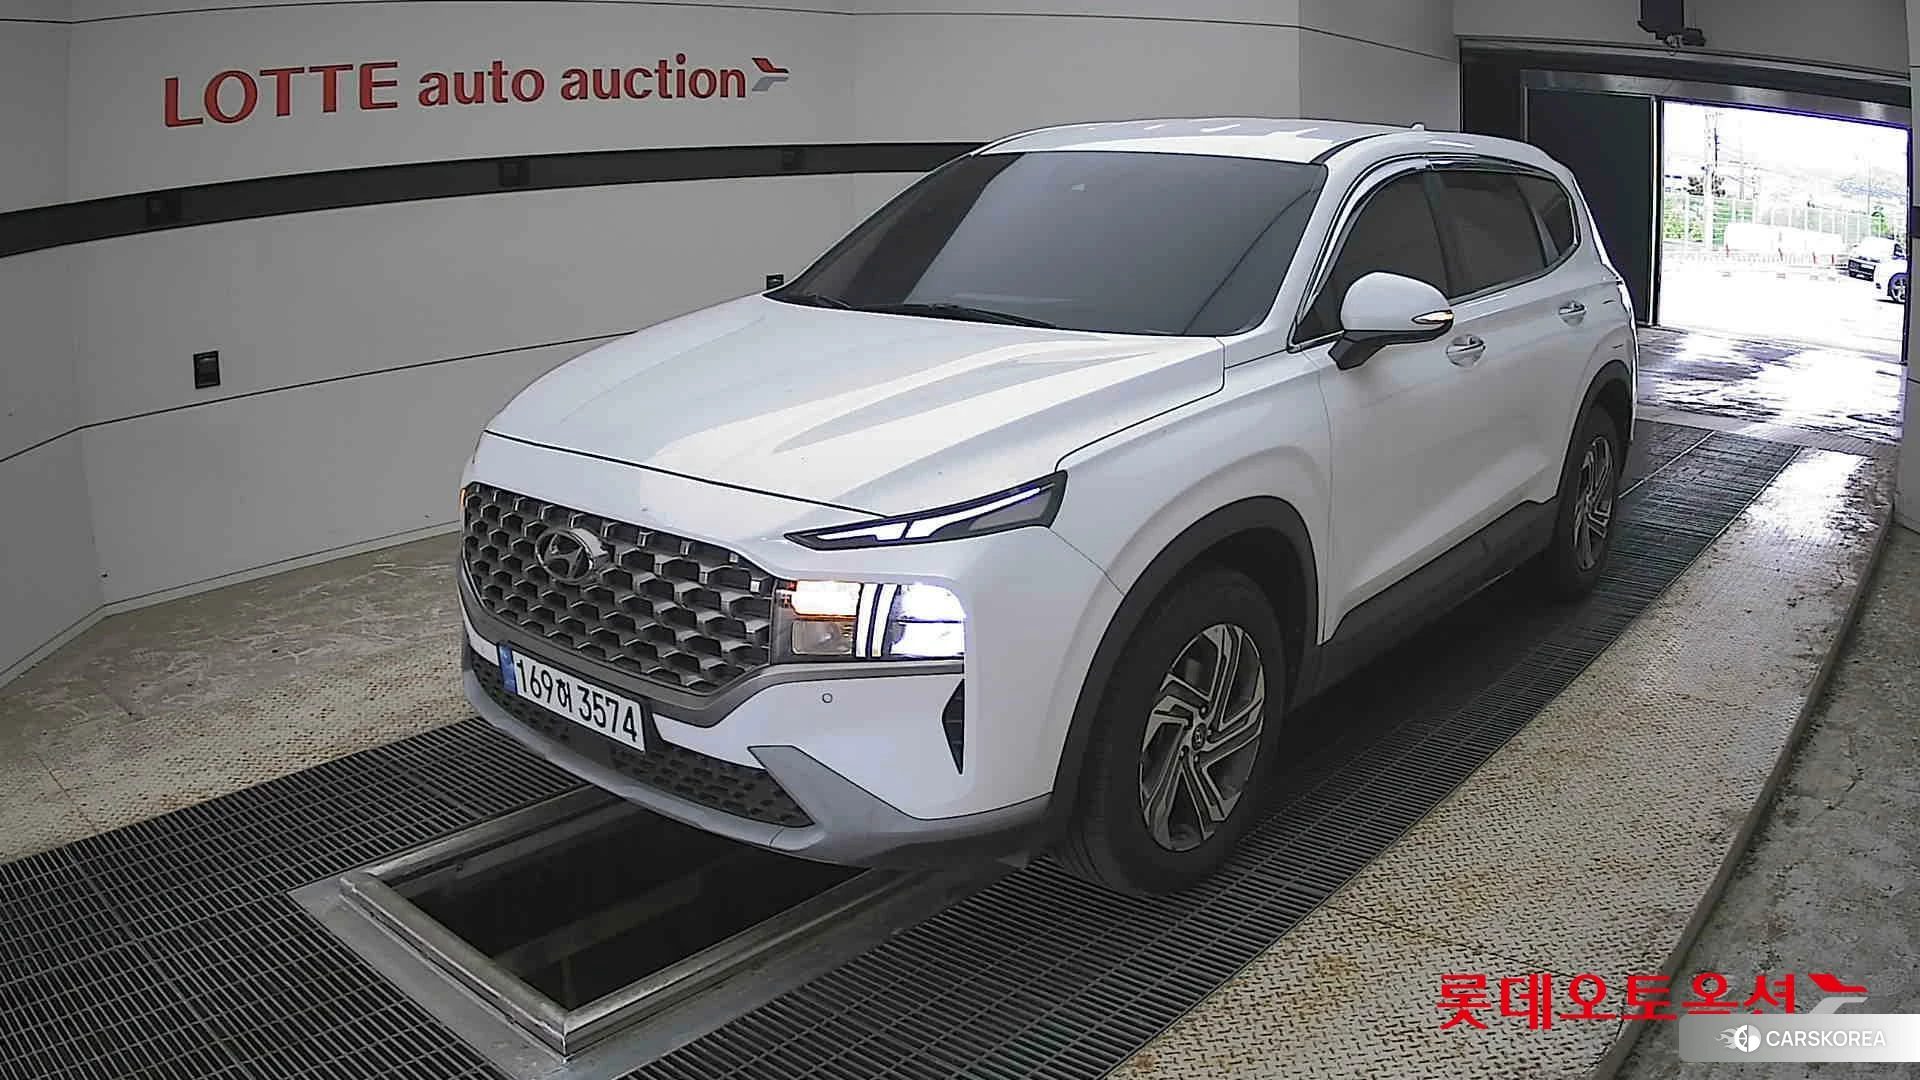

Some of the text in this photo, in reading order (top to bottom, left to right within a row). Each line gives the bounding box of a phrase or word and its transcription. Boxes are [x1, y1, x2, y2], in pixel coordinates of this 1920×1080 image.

[164, 52, 747, 128] LOTTE auto auction
[576, 685, 638, 742] 3574
